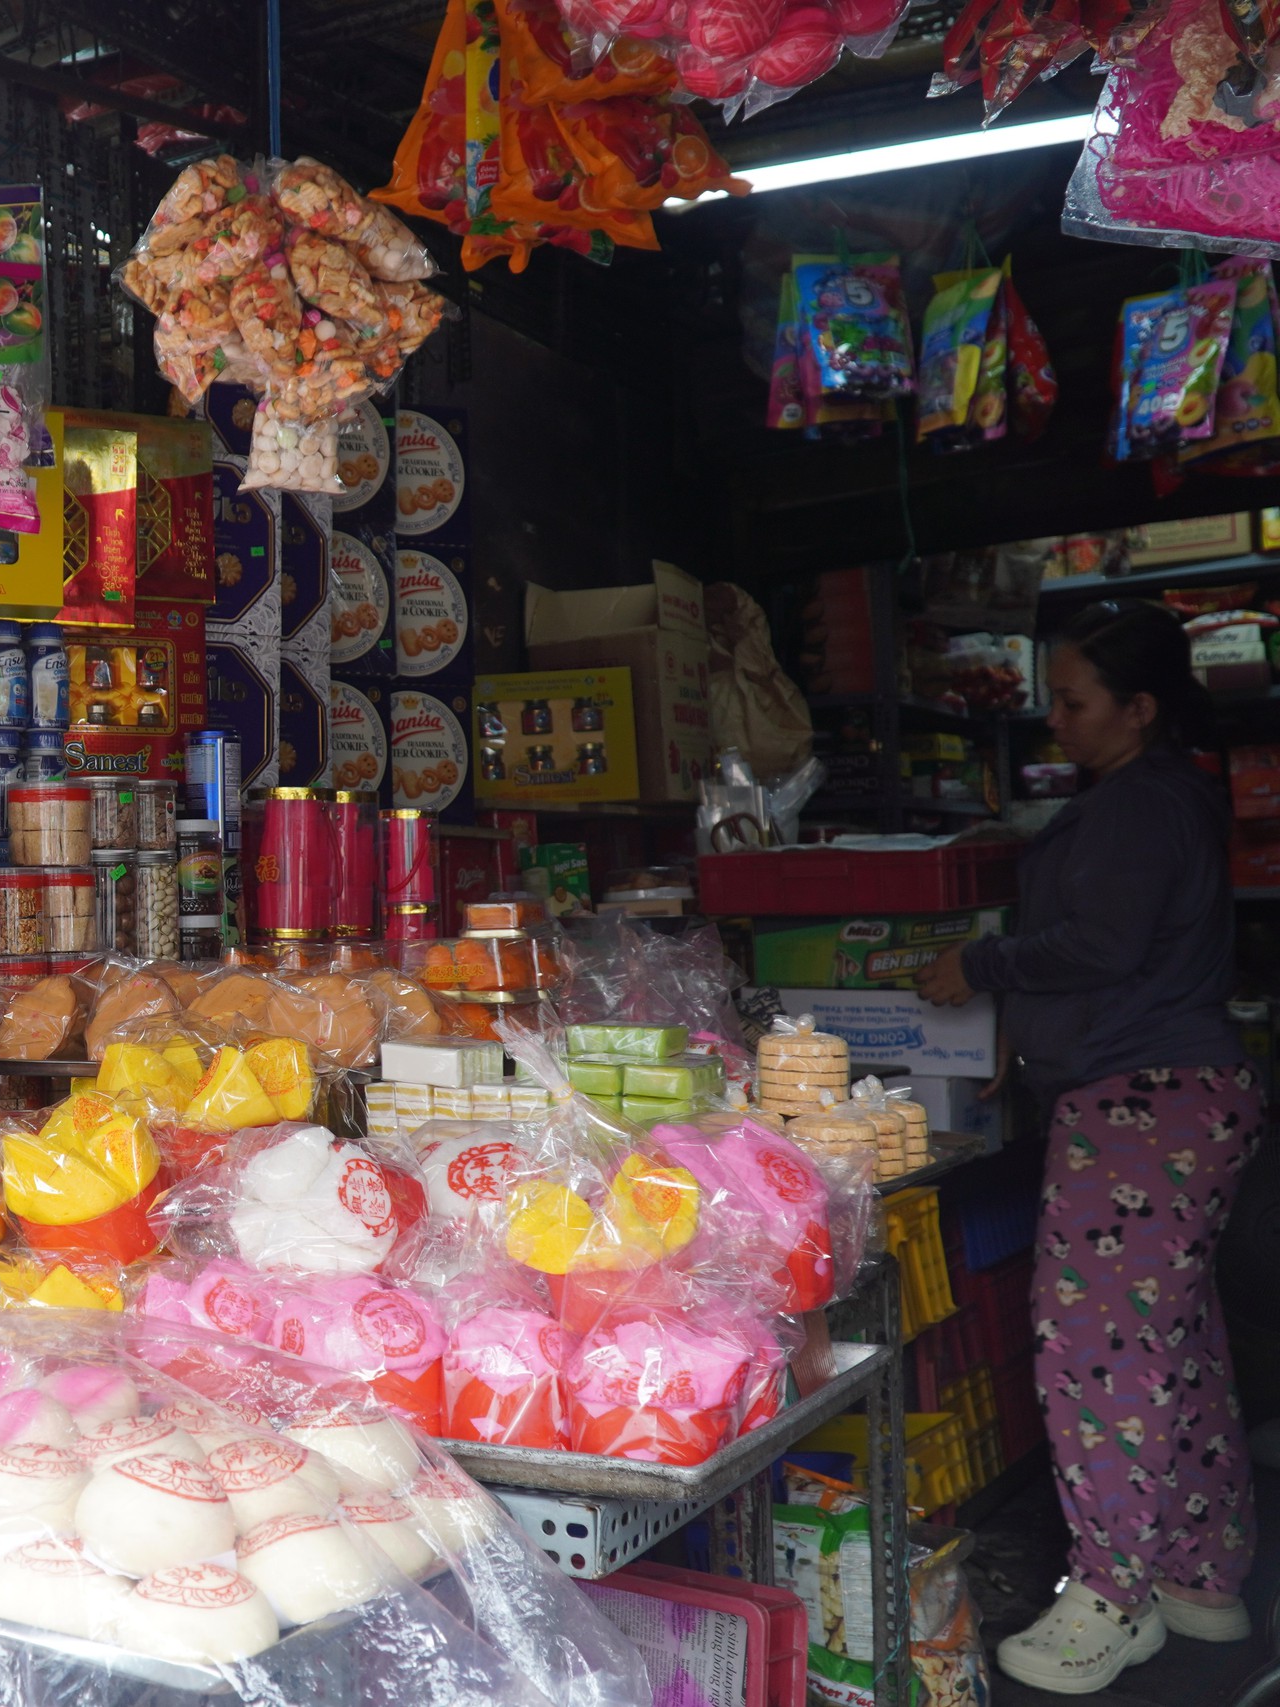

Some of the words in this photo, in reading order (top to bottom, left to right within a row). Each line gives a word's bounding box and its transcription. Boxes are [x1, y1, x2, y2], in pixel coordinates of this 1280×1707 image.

[65, 740, 148, 773] Sanest
[410, 748, 449, 758] COOKIES
[255, 856, 280, 882] 福
[872, 951, 900, 971] BỀN
[471, 1155, 498, 1196] 平安
[726, 1630, 738, 1659] sinh
